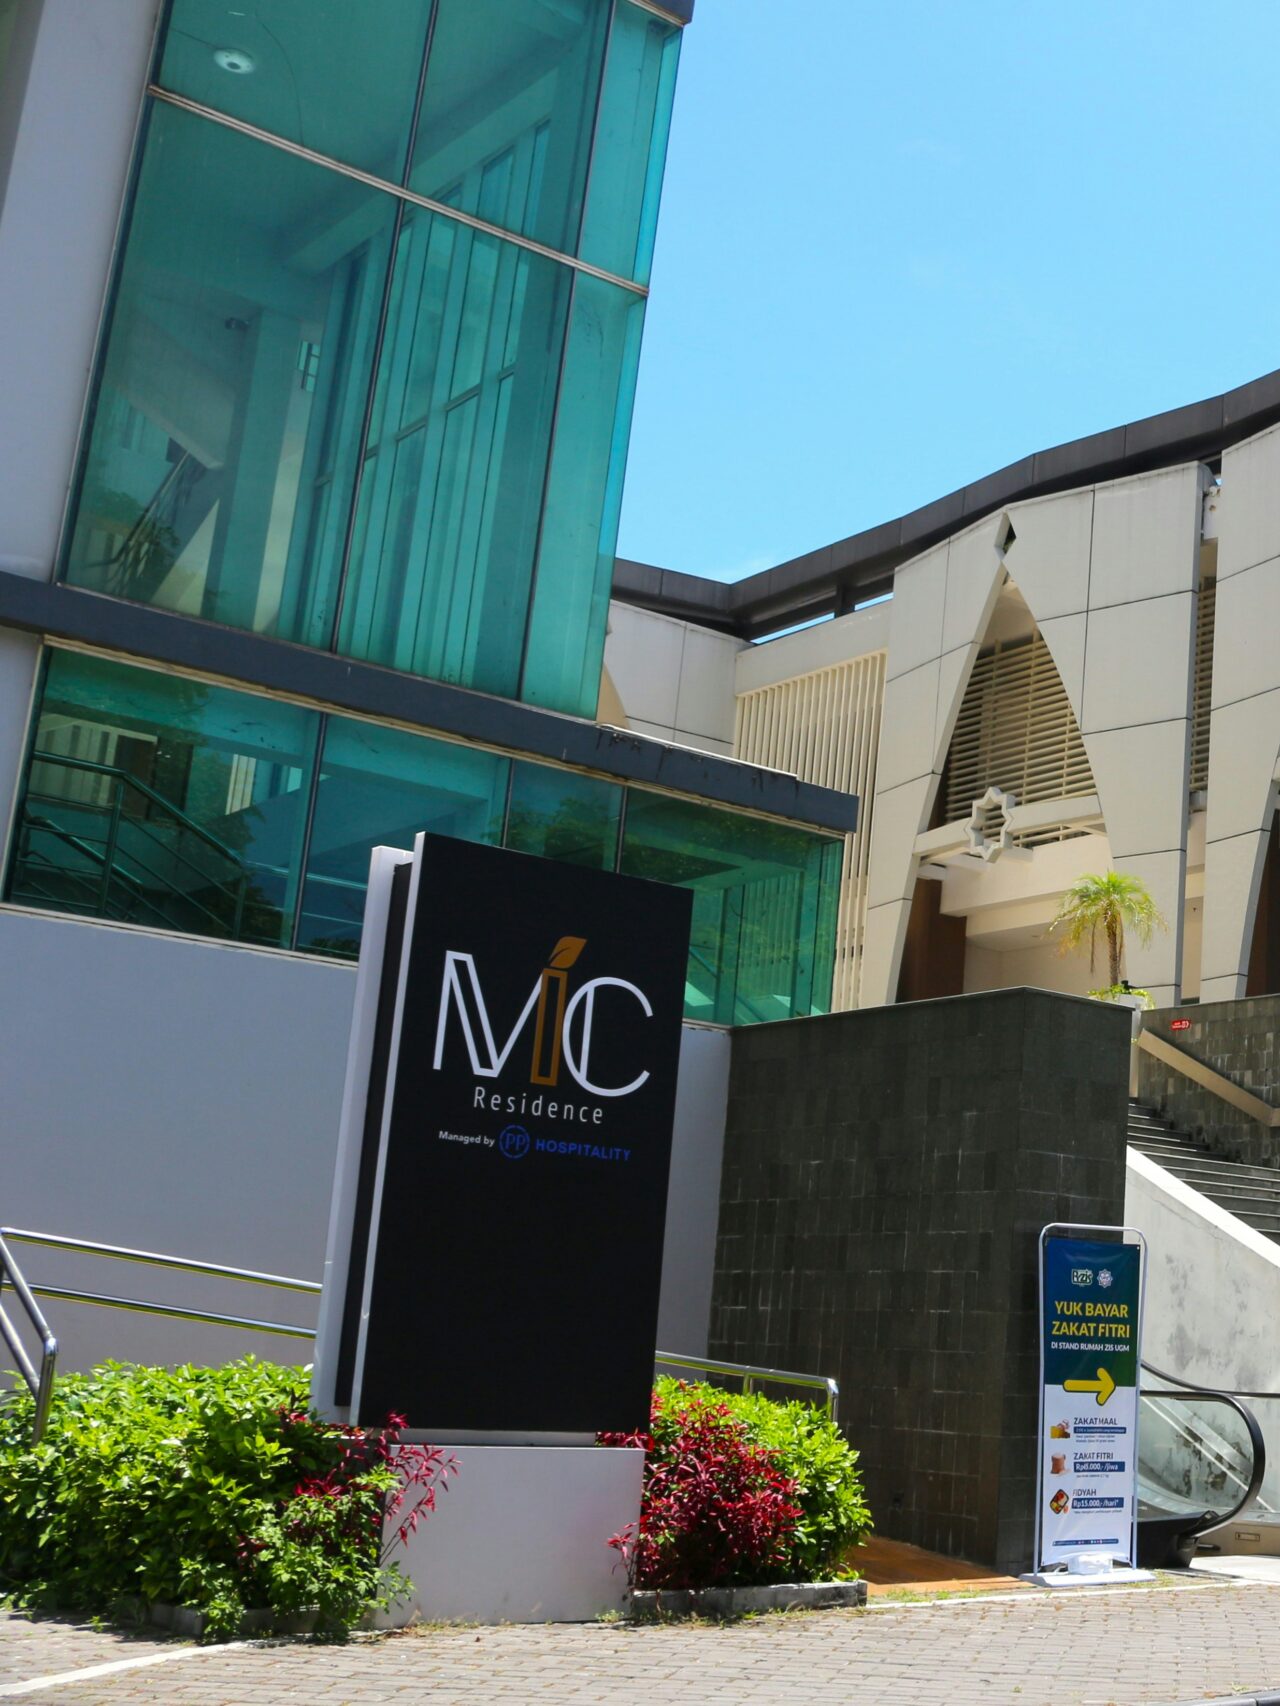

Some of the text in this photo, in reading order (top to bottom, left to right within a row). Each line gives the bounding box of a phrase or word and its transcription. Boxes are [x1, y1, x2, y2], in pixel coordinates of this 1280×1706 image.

[473, 1086, 603, 1124] Residence
[438, 1131, 482, 1145] Managed
[483, 1136, 495, 1147] by
[535, 1139, 631, 1161] HOSPITALITY
[1055, 1301, 1128, 1317] YUK BAYAR
[1052, 1322, 1129, 1337] ZAKAT FITRI
[1051, 1341, 1058, 1349] DI
[1059, 1342, 1079, 1350] STAND
[1080, 1343, 1104, 1351] RUMAH
[1073, 1417, 1099, 1425] ZAKAT
[1073, 1452, 1114, 1460] ZAKAT FITRI
[1072, 1488, 1097, 1497] FIDYAH
